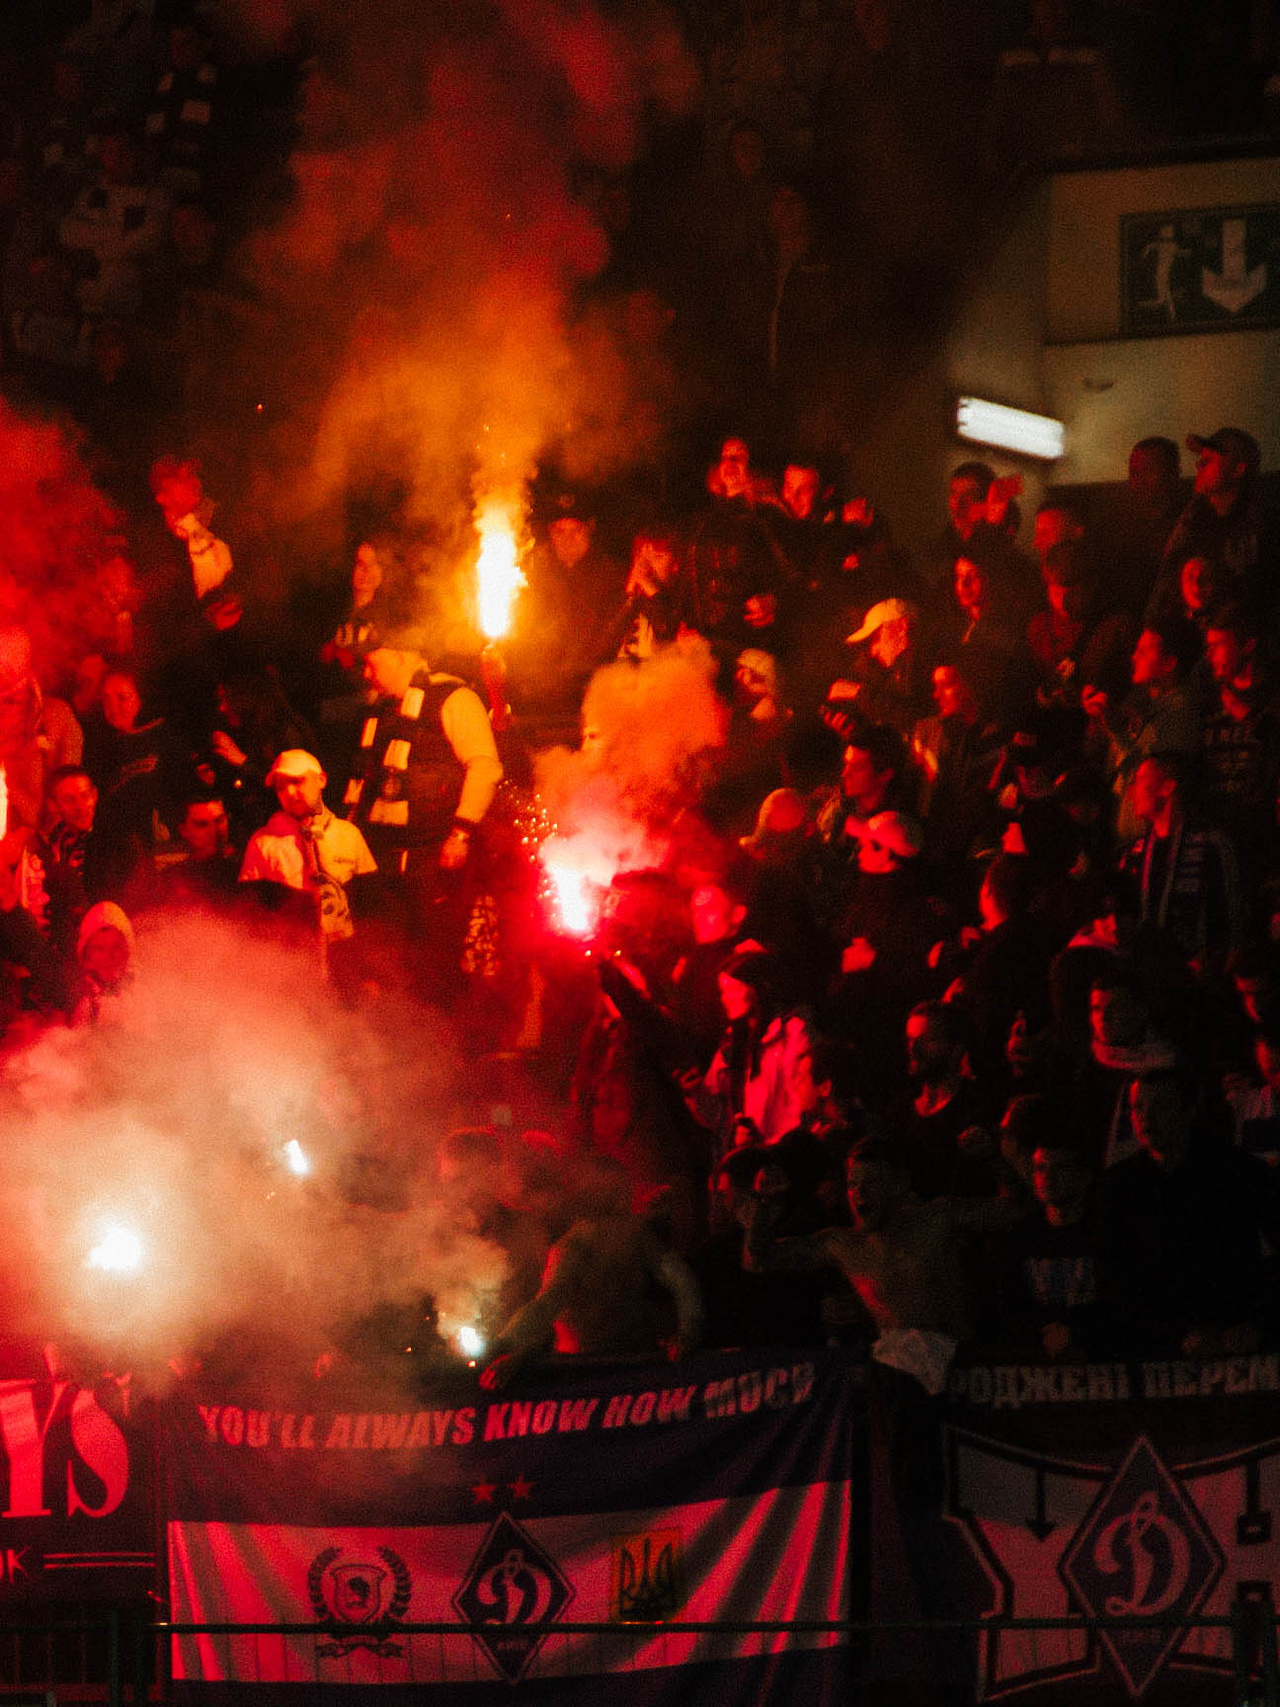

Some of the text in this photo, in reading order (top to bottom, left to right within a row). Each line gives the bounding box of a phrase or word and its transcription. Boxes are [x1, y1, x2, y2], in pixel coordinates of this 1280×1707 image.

[197, 1404, 315, 1448] YOU'LL
[324, 1406, 477, 1448] ALWAYS
[483, 1398, 599, 1442] KNOW
[602, 1385, 697, 1428] HOW
